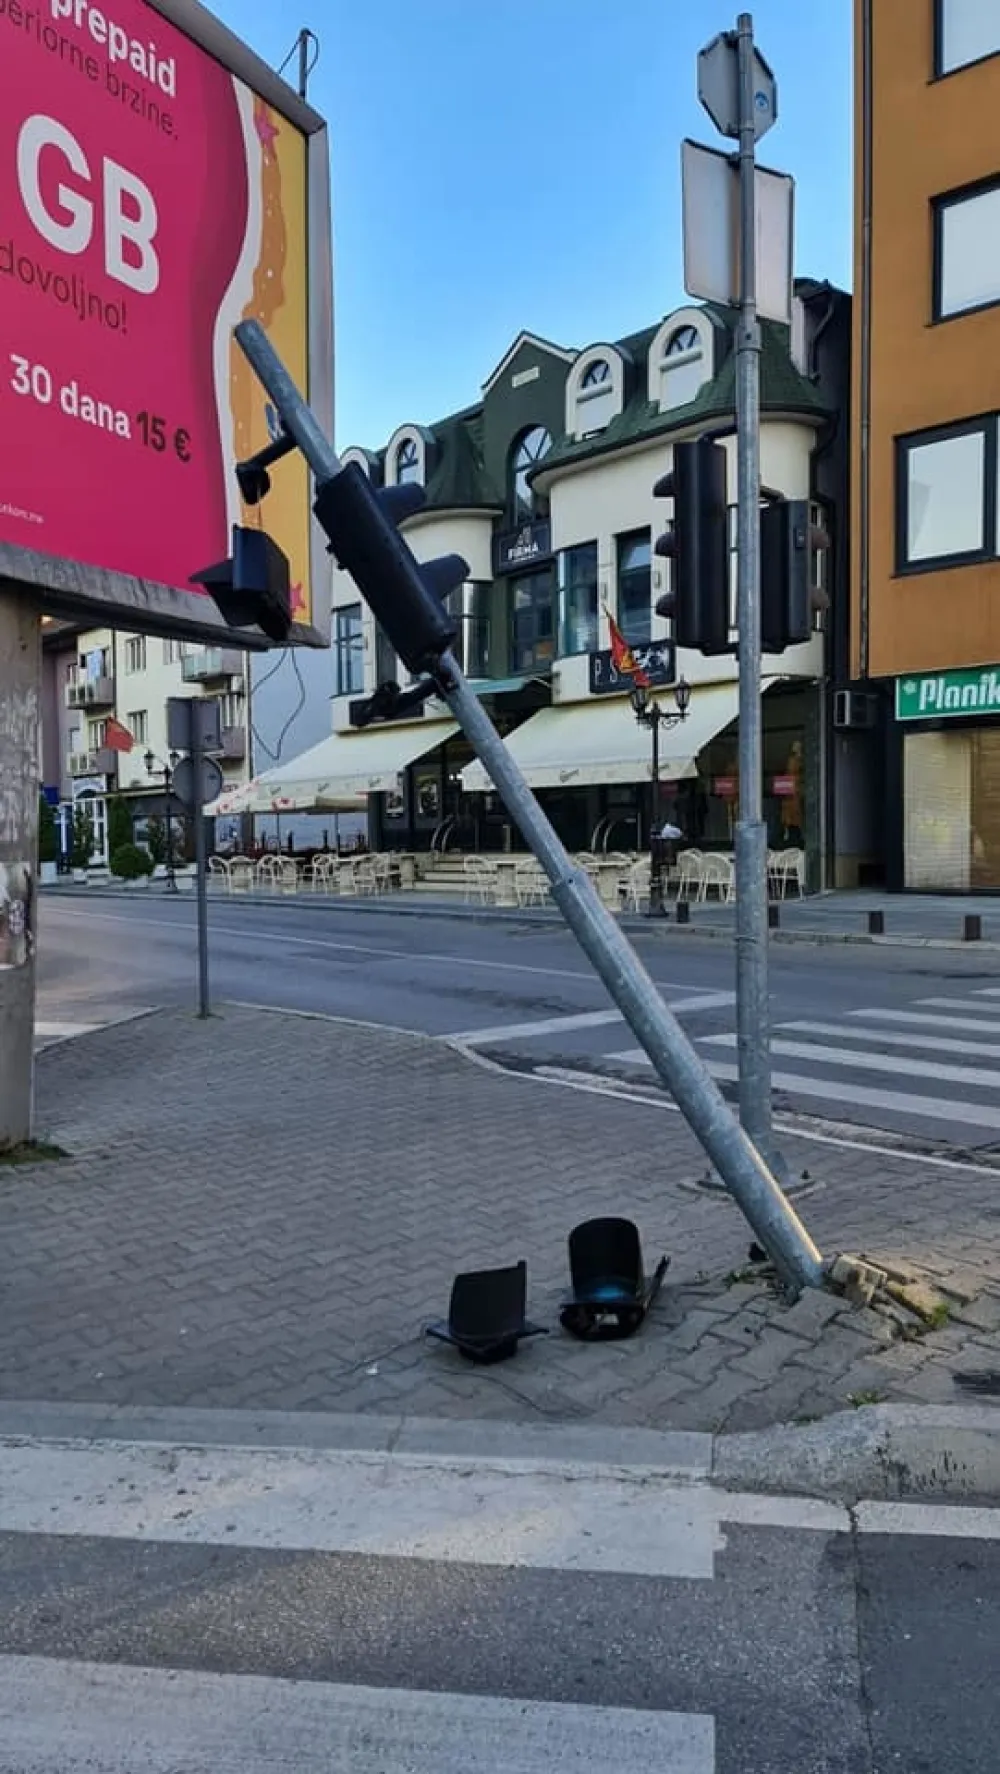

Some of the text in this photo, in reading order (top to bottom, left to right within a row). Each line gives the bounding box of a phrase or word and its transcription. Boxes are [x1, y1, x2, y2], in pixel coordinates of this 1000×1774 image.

[105, 63, 179, 141] brzine.
[16, 113, 160, 295] GB
[0, 239, 128, 336] dovoljno!
[9, 353, 192, 463] 30 dana 15 €
